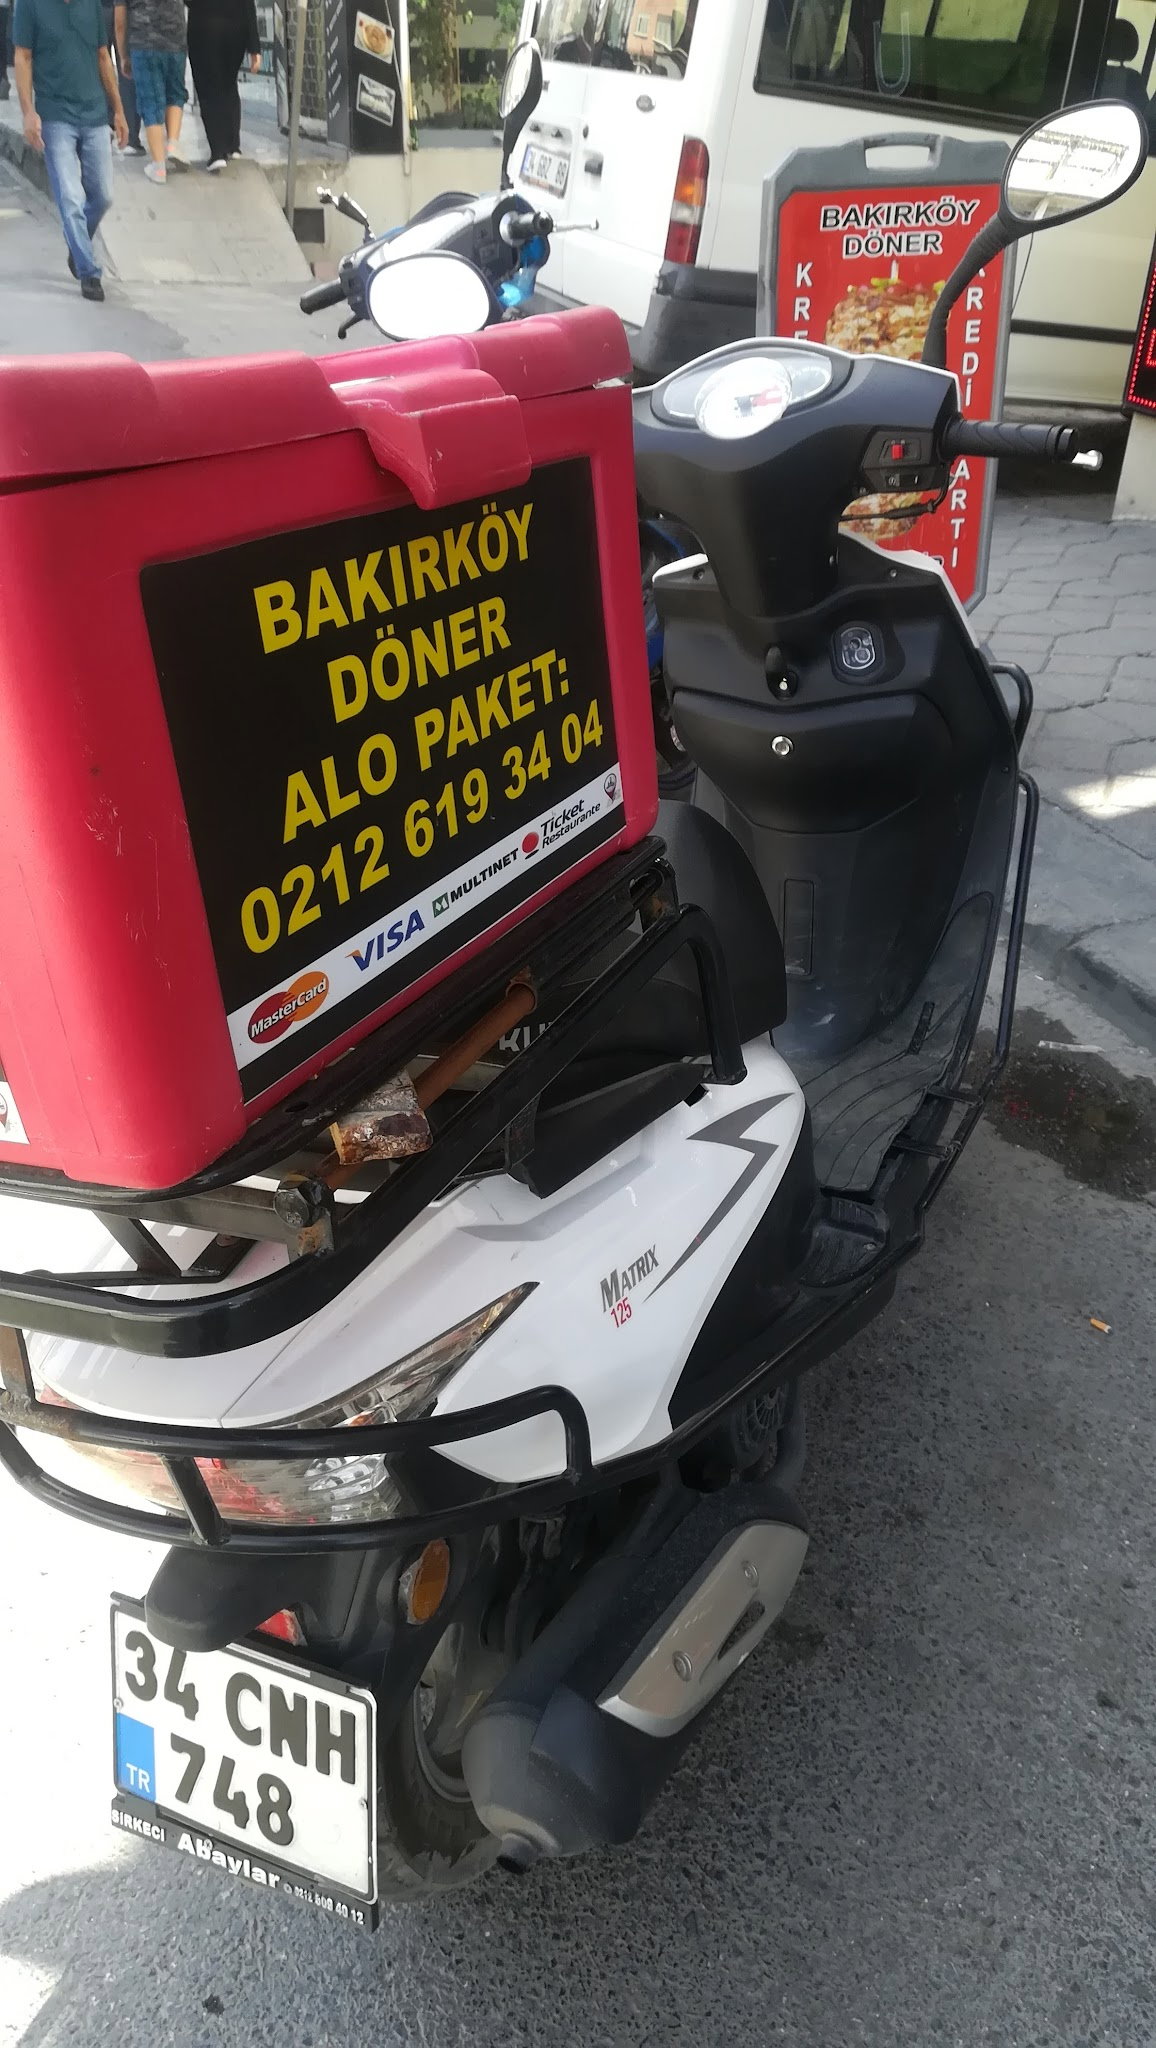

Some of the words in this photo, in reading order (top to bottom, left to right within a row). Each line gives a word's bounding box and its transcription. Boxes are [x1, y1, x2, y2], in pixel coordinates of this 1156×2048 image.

[820, 195, 980, 231] BAKIRKÖY
[843, 229, 943, 259] DÖNER
[961, 268, 986, 407] REDİ
[253, 502, 534, 654] BAKIRKÖY
[327, 596, 512, 723] DÖNER
[283, 733, 398, 844] ALO
[414, 649, 569, 772] PAKET:
[241, 825, 391, 953] 0212
[404, 768, 489, 858] 619
[502, 729, 551, 800] 34
[561, 698, 604, 764] 04
[540, 799, 585, 837] Ticket
[542, 803, 601, 849] Restaurante
[450, 848, 519, 903] MULTINET
[345, 909, 425, 971] VISA
[250, 977, 328, 1038] MasterCard
[610, 1296, 632, 1328] 125
[125, 1630, 200, 1721] 34
[225, 1672, 356, 1785] CNH
[126, 1763, 151, 1793] TR
[170, 1732, 295, 1846] 748
[177, 1832, 281, 1888] Abaylar
[350, 1909, 364, 1925] 12
